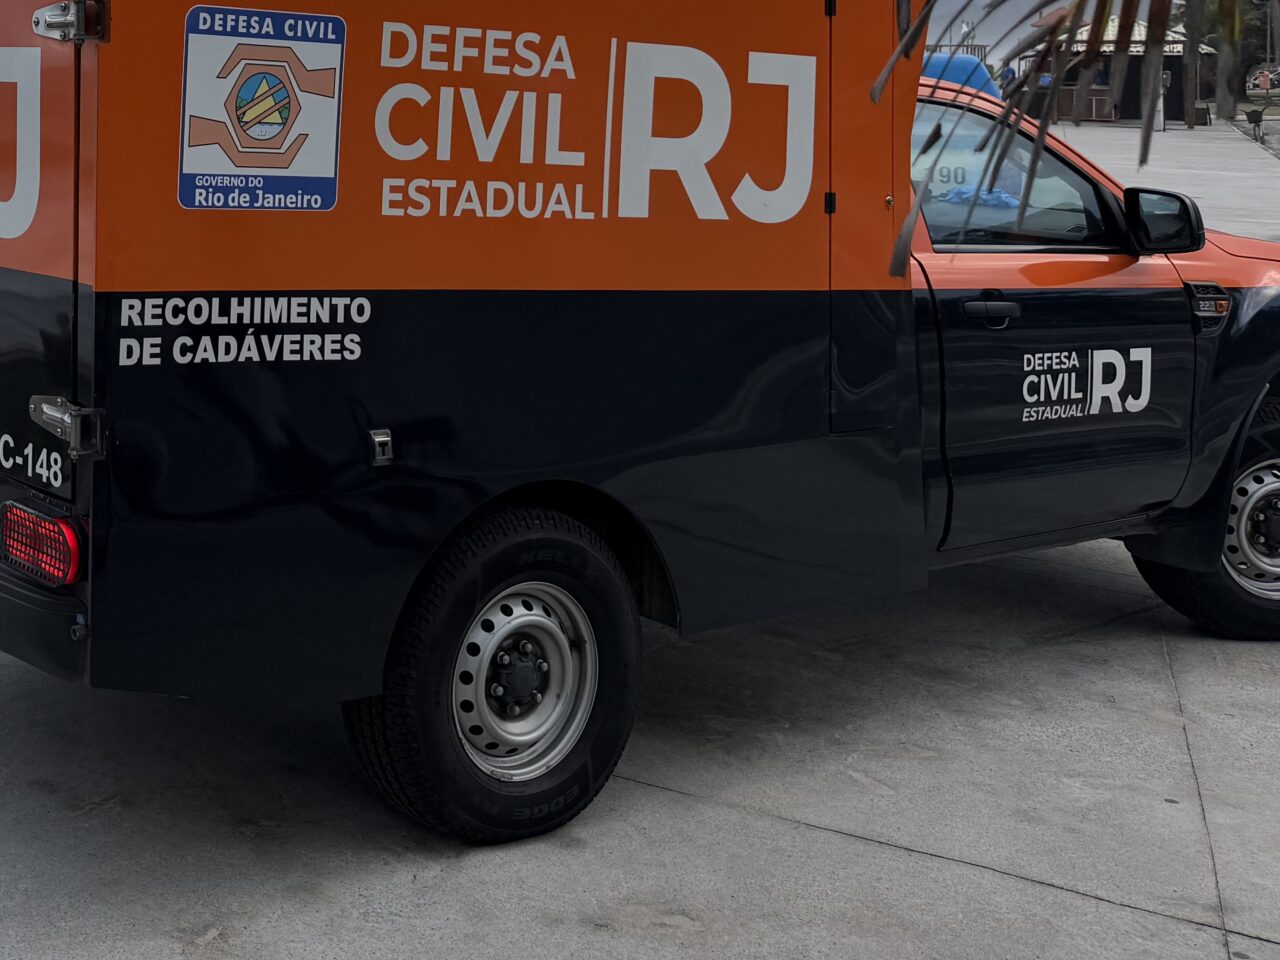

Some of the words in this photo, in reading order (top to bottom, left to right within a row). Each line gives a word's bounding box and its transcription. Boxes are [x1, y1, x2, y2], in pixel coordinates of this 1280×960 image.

[199, 12, 274, 35] DEFESA
[284, 19, 336, 39] CIVIL
[380, 21, 576, 80] DEFESA
[374, 82, 586, 166] CIVIL
[618, 41, 817, 224] RJ
[195, 176, 246, 187] GOVERNO
[248, 177, 263, 187] DO
[194, 188, 224, 206] Rio
[228, 188, 249, 208] de
[254, 190, 321, 209] Janeiro
[381, 177, 595, 220] ESTADUAL
[120, 297, 372, 326] RECOLHIMENTO
[119, 337, 162, 366] DE
[173, 328, 362, 364] CADÁVERES
[1023, 351, 1080, 371] DEFESA
[1022, 372, 1083, 403] CIVIL
[1090, 347, 1152, 415] RJ
[1022, 403, 1083, 422] ESTADUAL
